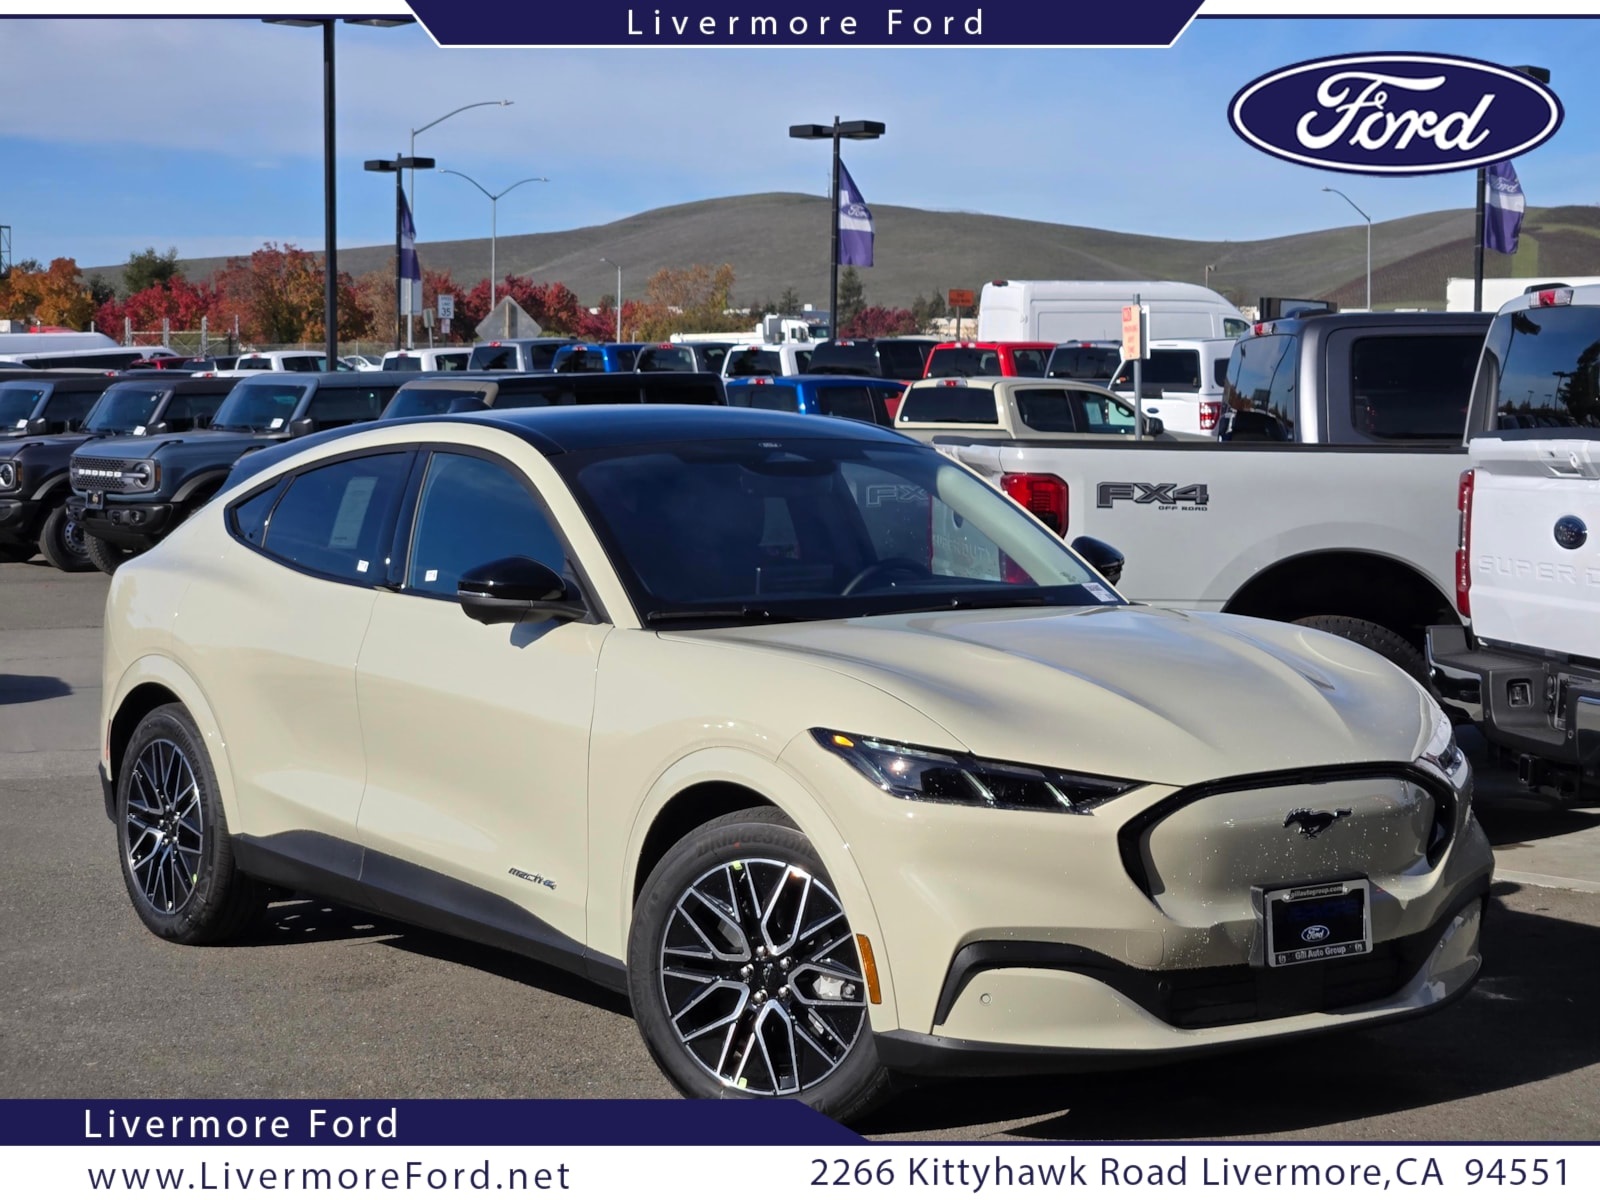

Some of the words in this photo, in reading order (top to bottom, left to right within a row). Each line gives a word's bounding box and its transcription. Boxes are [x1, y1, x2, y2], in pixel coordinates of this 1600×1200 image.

[441, 307, 452, 316] 35
[79, 468, 122, 478] BRONCO
[866, 485, 928, 507] FX
[1096, 481, 1209, 509] FX4
[1479, 553, 1577, 585] SUPER
[1295, 951, 1308, 960] Gill
[1308, 948, 1324, 958] Auto
[1325, 946, 1346, 956] Group
